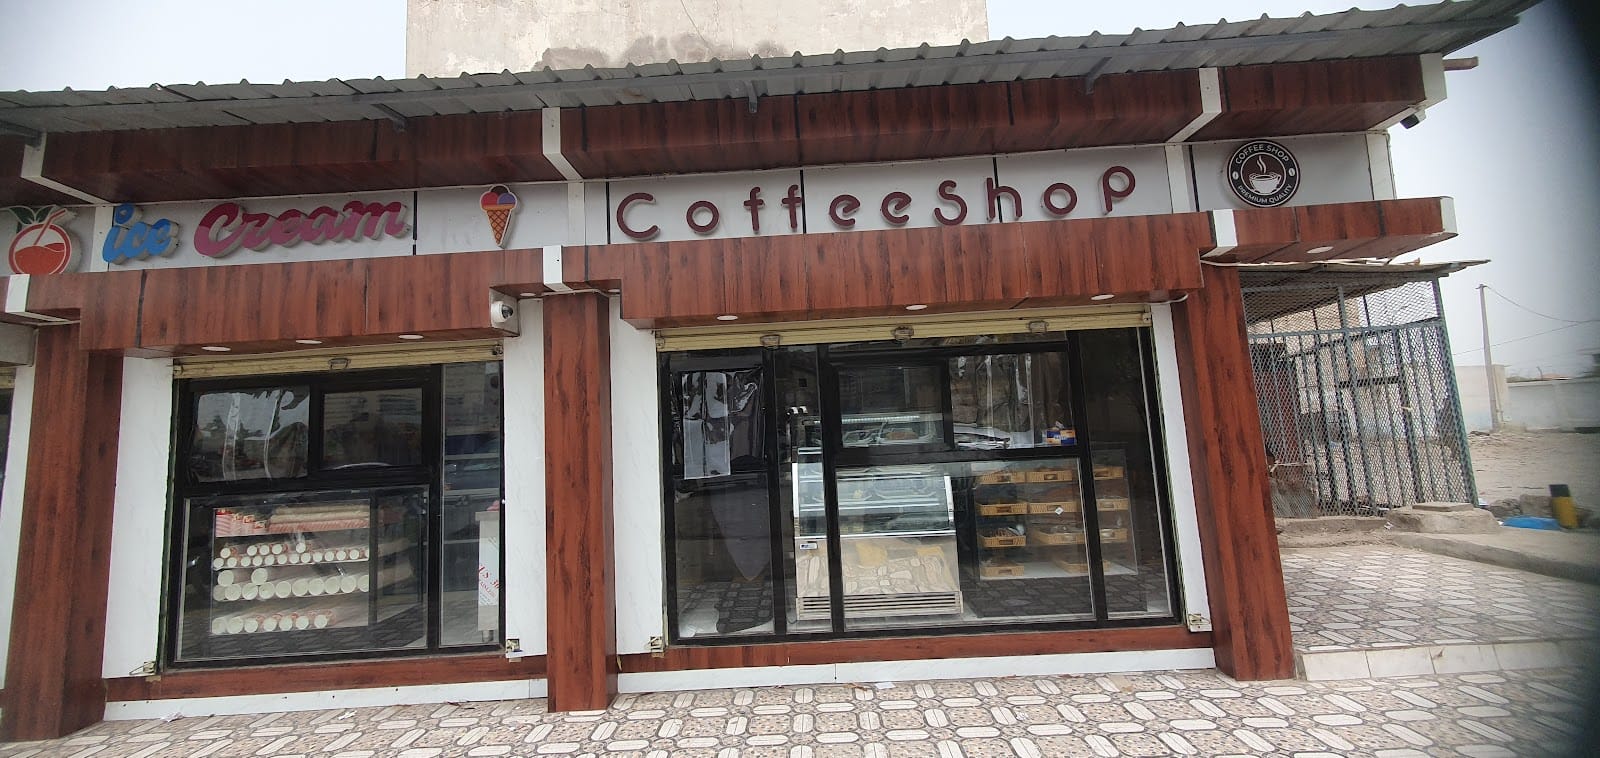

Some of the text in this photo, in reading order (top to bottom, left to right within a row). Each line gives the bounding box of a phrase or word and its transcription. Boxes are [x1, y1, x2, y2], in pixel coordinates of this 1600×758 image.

[1235, 145, 1289, 164] COFFEE SHOP
[1238, 183, 1293, 203] PREMIUM QUALITY
[102, 200, 410, 264] ice Cream
